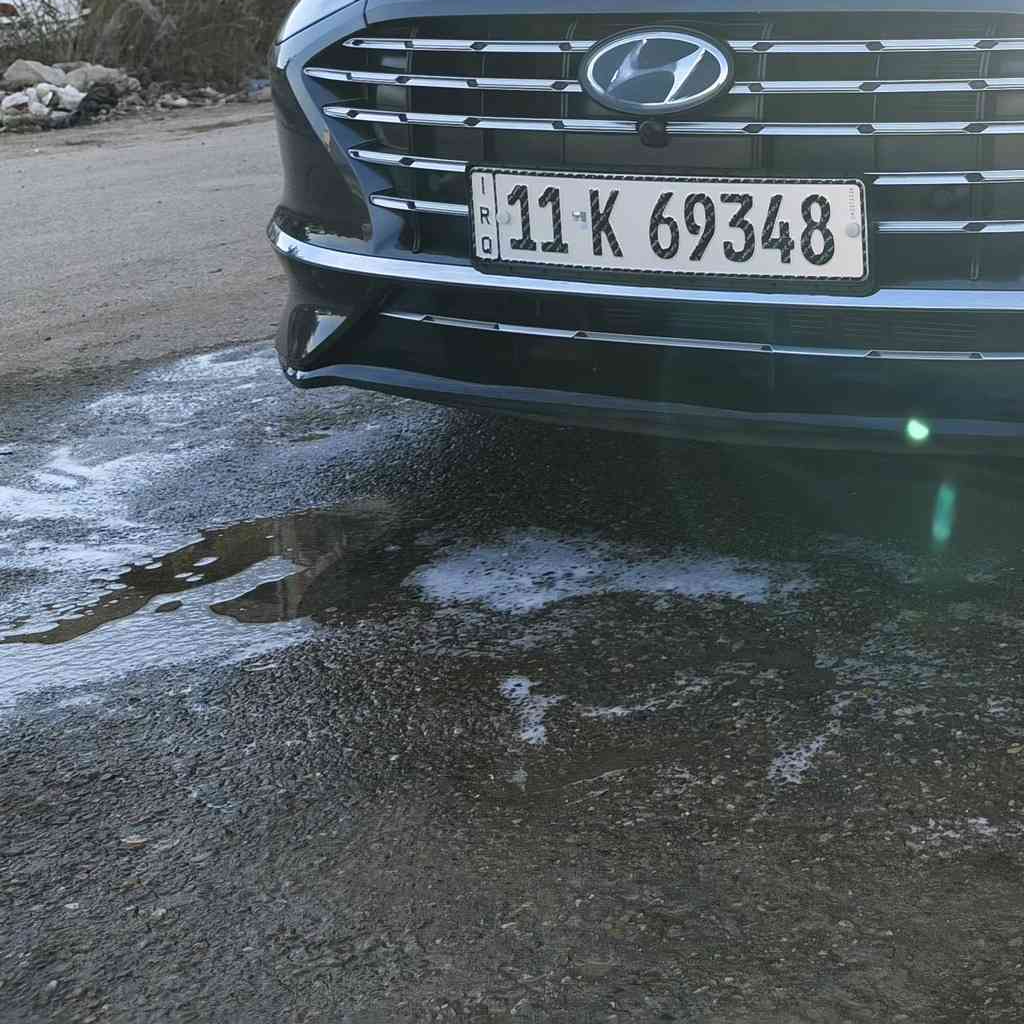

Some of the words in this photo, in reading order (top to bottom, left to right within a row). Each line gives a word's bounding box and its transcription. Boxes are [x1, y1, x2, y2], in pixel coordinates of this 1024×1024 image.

[507, 184, 568, 254] 11
[588, 189, 624, 257] K
[650, 191, 835, 265] 69348
